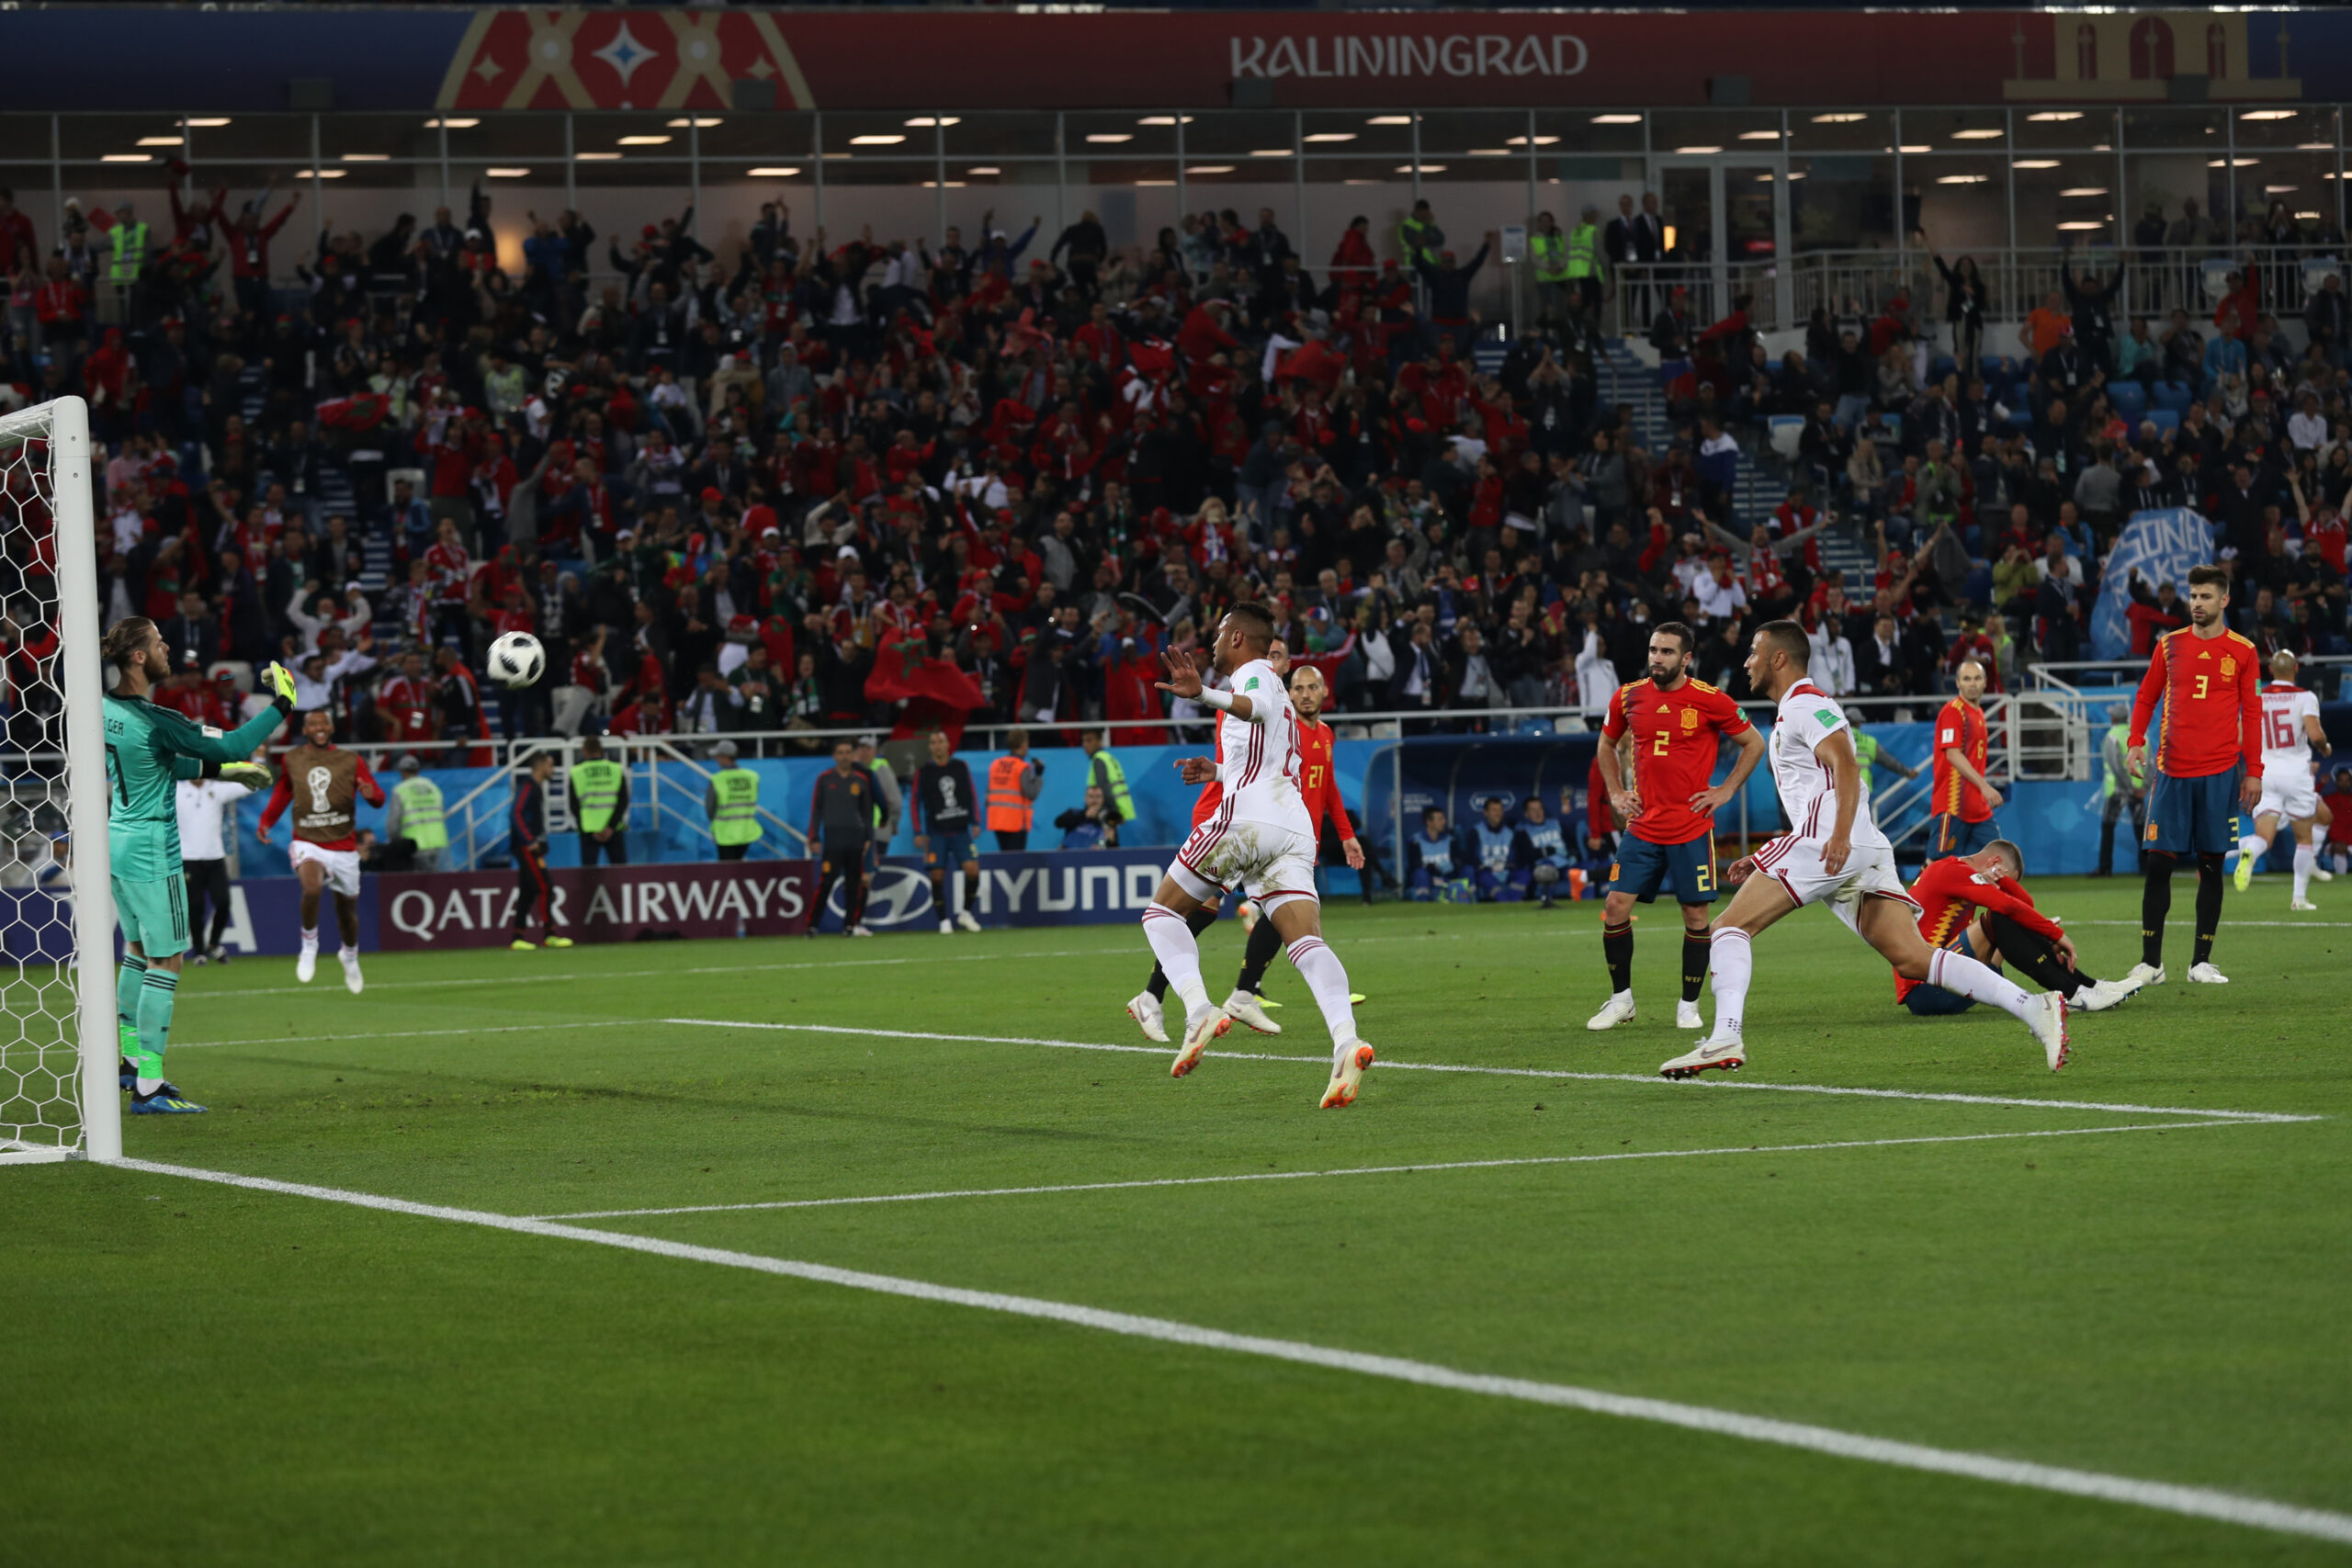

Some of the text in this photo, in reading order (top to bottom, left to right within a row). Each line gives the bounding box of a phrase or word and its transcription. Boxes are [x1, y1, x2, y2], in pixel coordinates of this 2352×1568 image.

[1230, 35, 1589, 78] KALININGRAD
[2192, 675, 2209, 699] 3
[2262, 709, 2295, 750] 16
[1654, 731, 1669, 756] 2
[1977, 739, 1984, 760] 6
[1308, 765, 1325, 789] 21
[953, 863, 1165, 915] HYUND
[1697, 865, 1711, 892] 2
[390, 876, 805, 941] QATAR AIRWAYS
